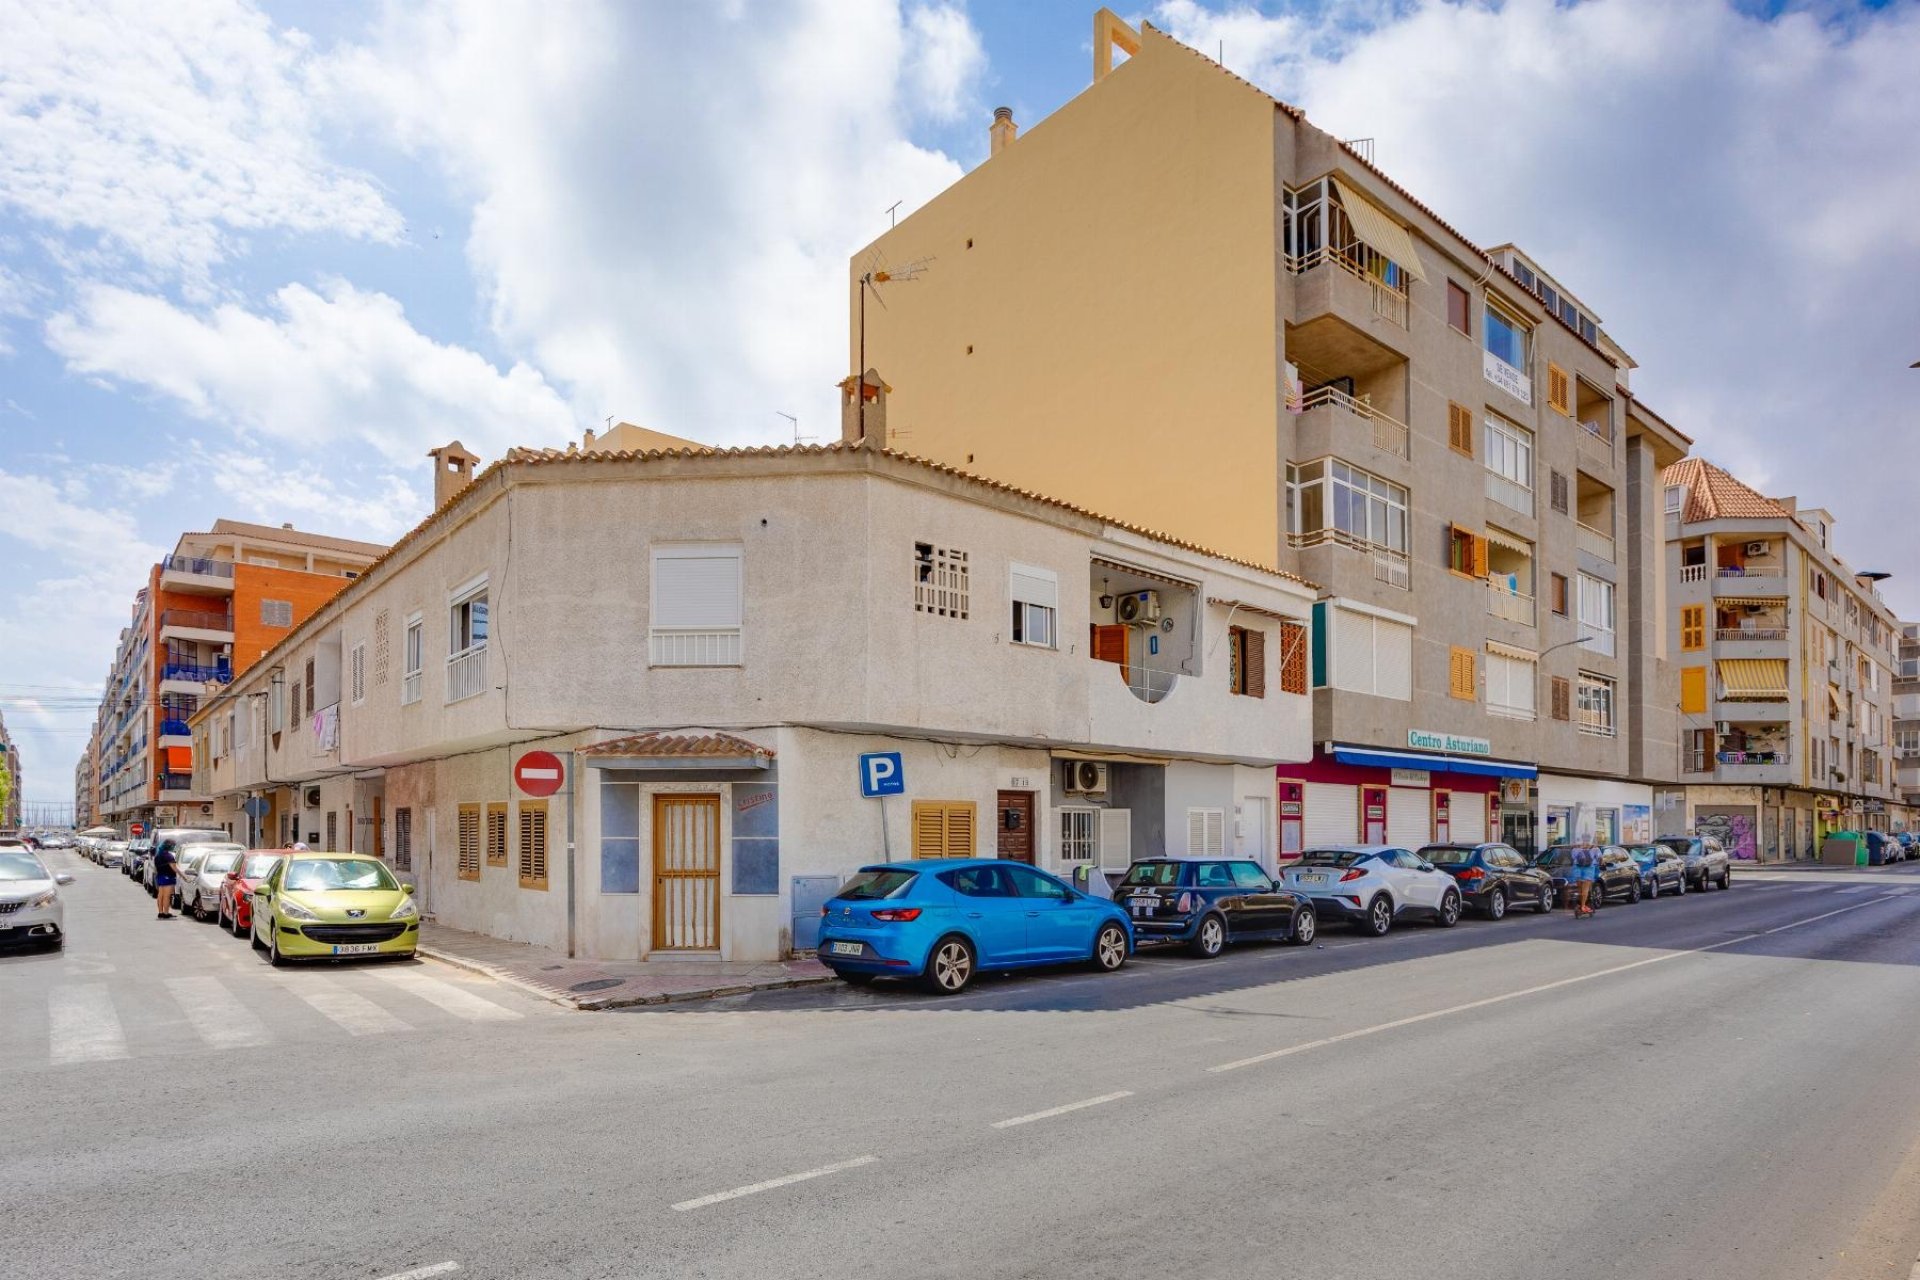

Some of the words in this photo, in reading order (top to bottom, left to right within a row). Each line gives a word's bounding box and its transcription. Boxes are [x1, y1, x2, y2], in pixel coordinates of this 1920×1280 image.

[1410, 731, 1442, 748] Centro
[1445, 736, 1489, 754] Asturiano
[869, 757, 895, 791] P
